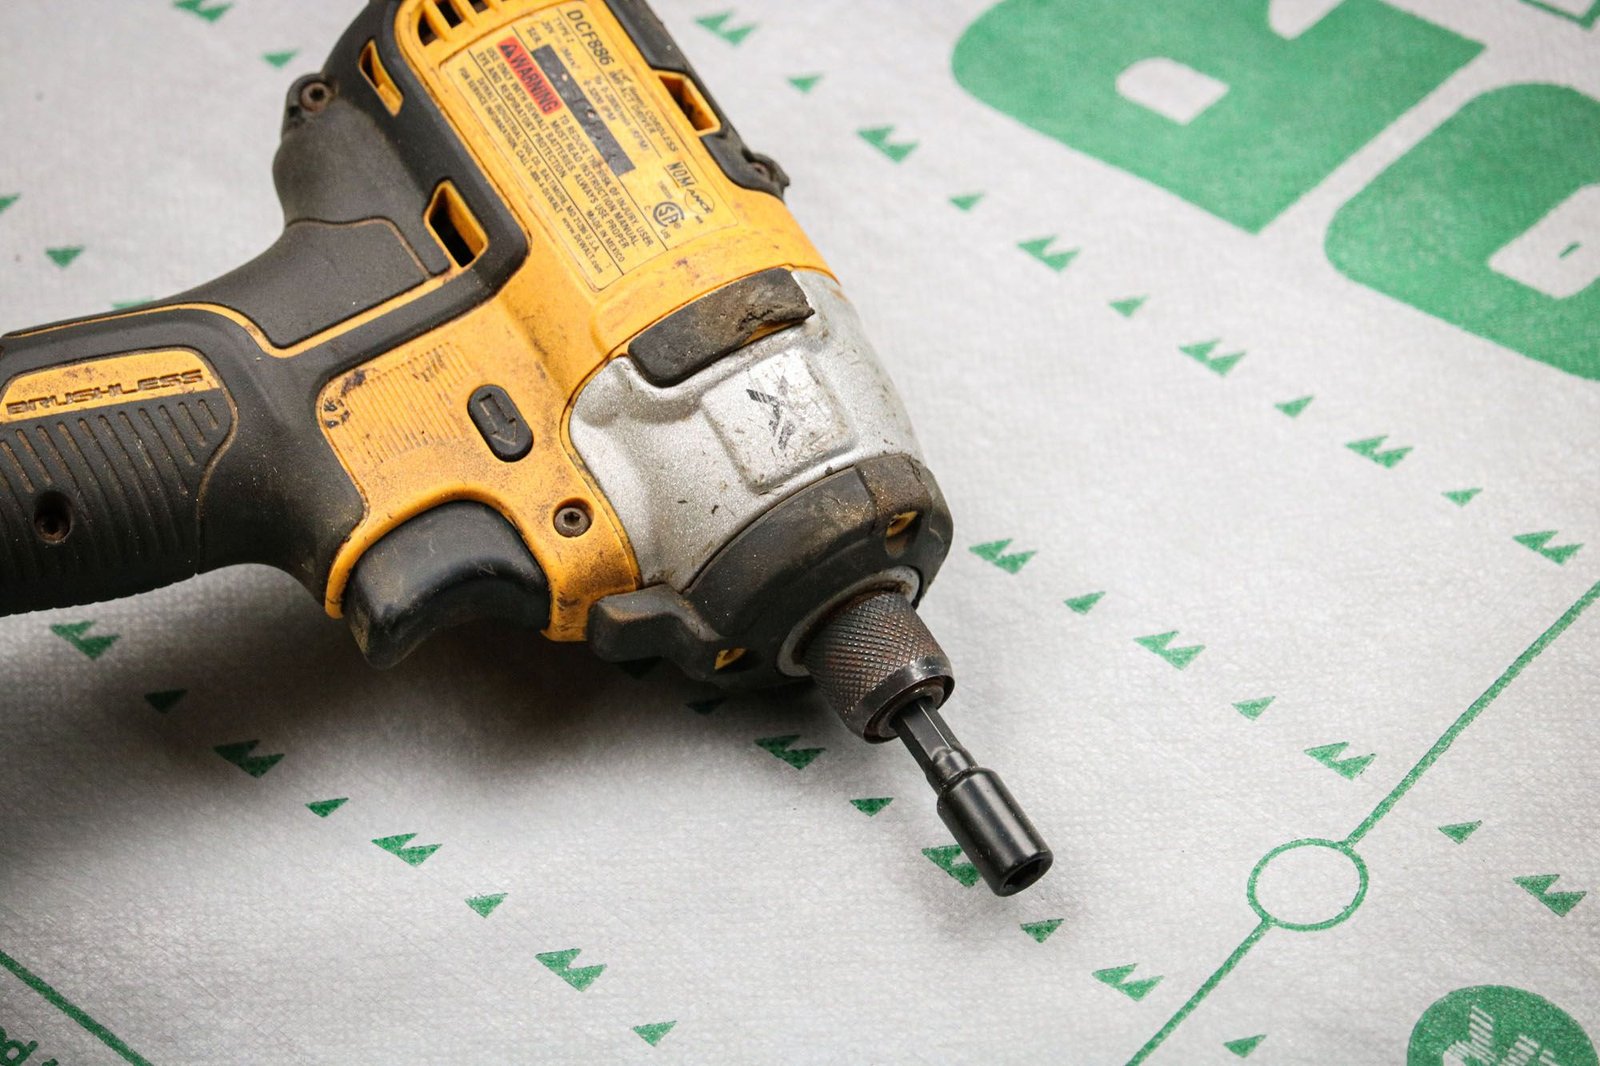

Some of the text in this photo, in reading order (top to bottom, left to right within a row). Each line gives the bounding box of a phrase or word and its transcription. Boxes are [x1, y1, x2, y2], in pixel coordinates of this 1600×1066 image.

[551, 16, 570, 37] TYPE
[565, 9, 616, 66] DCF886
[475, 51, 491, 67] EYE
[486, 66, 503, 84] AND
[497, 83, 537, 132] RESPIRATORY
[507, 52, 560, 113] WARNING
[608, 70, 657, 133] IMPACT DRIVER
[457, 66, 471, 80] FOR
[465, 79, 489, 106] SERVICE
[514, 149, 530, 166] CALL
[643, 109, 679, 152] CORDLESS
[484, 46, 500, 61] USE
[495, 61, 514, 81] ONLY
[509, 81, 529, 102] WITH
[572, 172, 599, 204] ALWAYS
[593, 203, 610, 220] USE
[604, 218, 630, 249] PROPER
[493, 103, 524, 140] INDUSTRIAL
[518, 139, 535, 156] TOOL
[564, 204, 577, 217] MD
[549, 119, 570, 143] MUST
[564, 142, 584, 163] READ
[578, 162, 618, 212] INSTRUCTION
[665, 161, 695, 188] NOM
[558, 114, 571, 125] TO
[565, 125, 590, 154] REDUCE
[585, 153, 601, 170] THE
[596, 168, 613, 186] RISK
[608, 186, 621, 198] OF
[635, 225, 655, 247] USER
[584, 209, 603, 230] MADE
[598, 228, 609, 238] IN
[659, 227, 671, 240] US
[603, 237, 626, 263] MEXICO
[6, 369, 203, 415] BRUSHLESS
